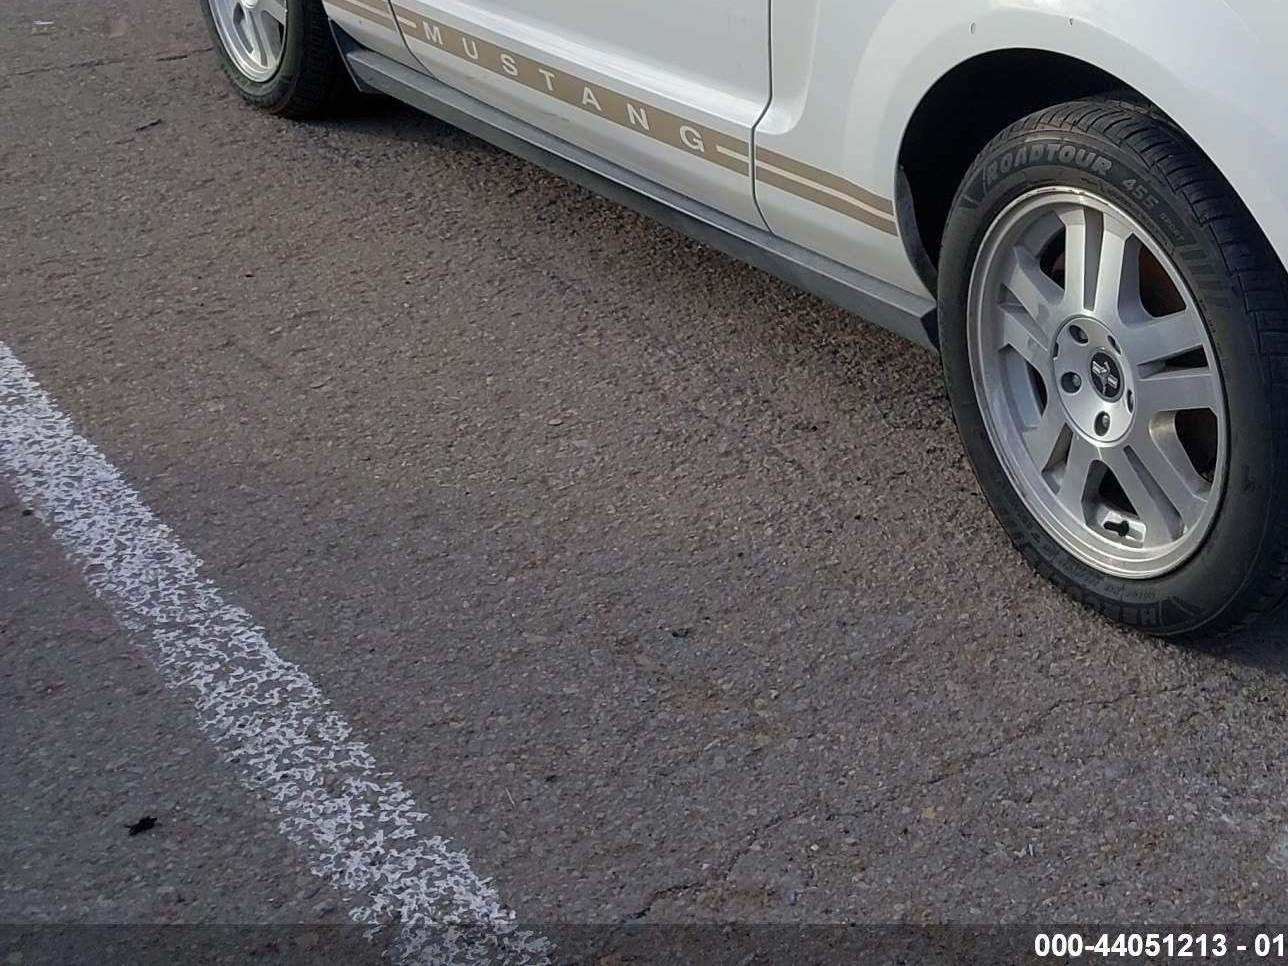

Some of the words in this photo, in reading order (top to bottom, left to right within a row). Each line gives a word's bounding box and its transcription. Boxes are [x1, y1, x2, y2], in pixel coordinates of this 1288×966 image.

[422, 21, 706, 153] MUSTANG
[985, 143, 1114, 185] ROADTOUR
[1122, 177, 1161, 208] 455
